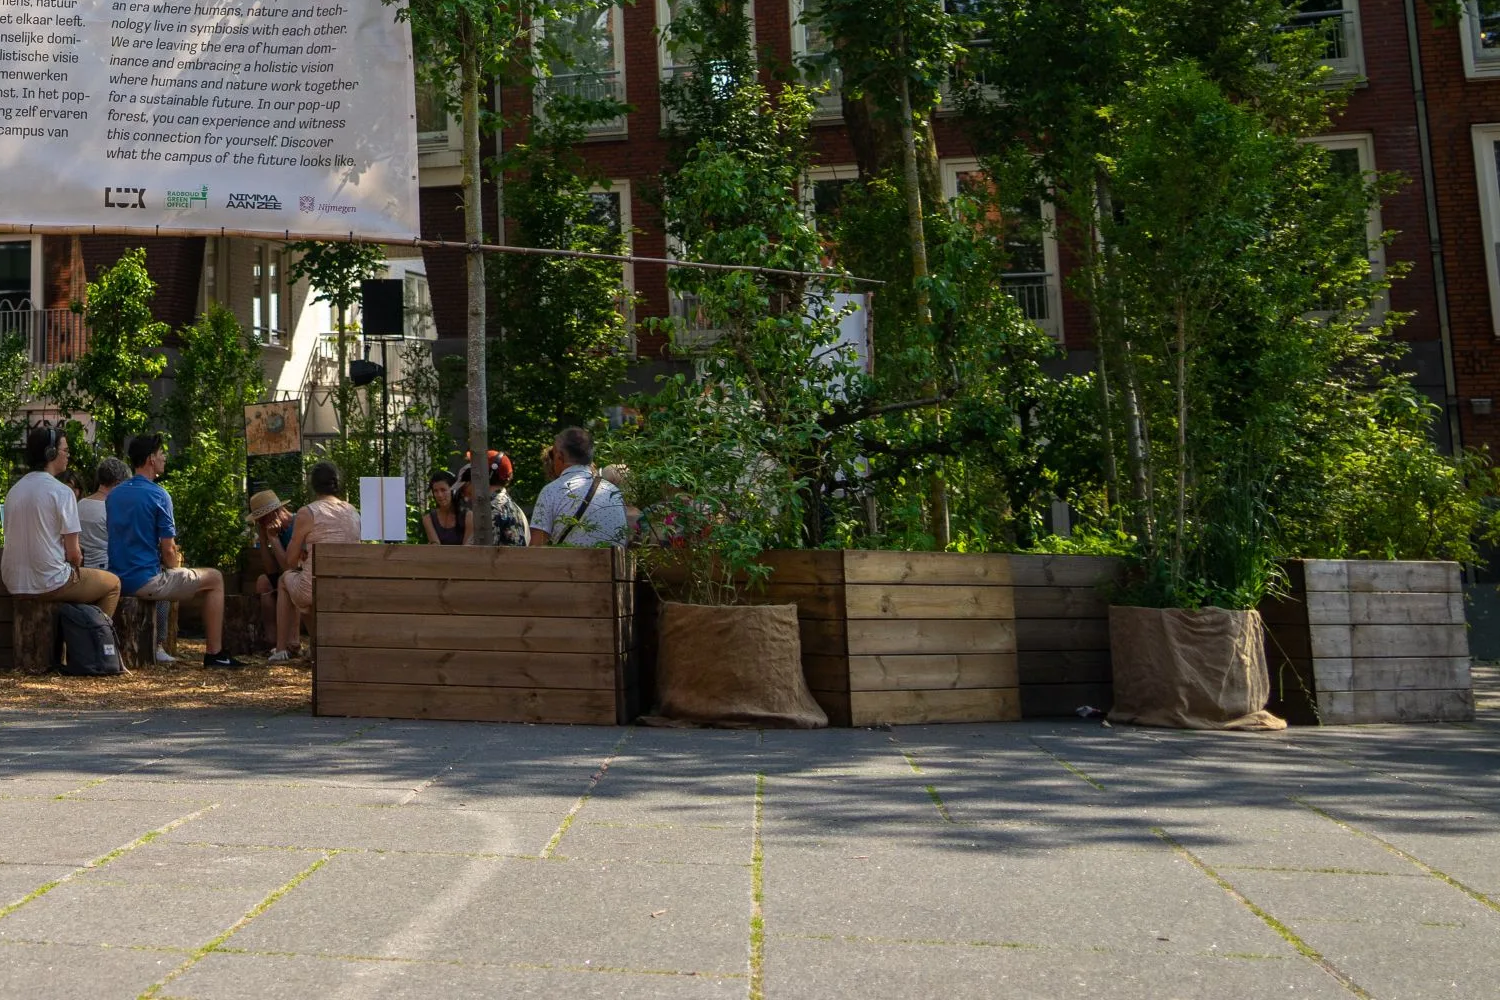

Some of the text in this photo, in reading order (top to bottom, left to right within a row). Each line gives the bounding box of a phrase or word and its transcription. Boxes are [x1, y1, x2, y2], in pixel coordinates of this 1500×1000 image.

[15, 13, 52, 25] elkaar
[55, 15, 85, 26] leeft.
[110, 18, 151, 34] nology
[153, 20, 174, 31] live
[176, 21, 187, 32] in
[189, 23, 249, 38] symbiosis
[251, 24, 279, 35] with
[281, 25, 311, 36] each
[47, 32, 80, 44] domi-
[110, 35, 336, 55] We are leaving the era of human dom-
[52, 52, 78, 63] visie
[109, 55, 334, 74] inance and embracing a holistic vision
[108, 73, 358, 94] where humans and nature work together
[22, 87, 35, 98] In
[38, 88, 59, 99] het
[61, 92, 89, 104] pop-
[108, 91, 340, 113] for a sustainable future. In our pop-up
[107, 109, 346, 130] forest, you can experience and witness
[47, 128, 68, 138] van
[106, 128, 333, 149] this connection for yourself. Discover
[105, 147, 357, 166] what the campus of the future looks like.
[104, 187, 146, 208] LUX
[229, 193, 278, 202] NIMMA
[318, 203, 357, 214] Nijmegen
